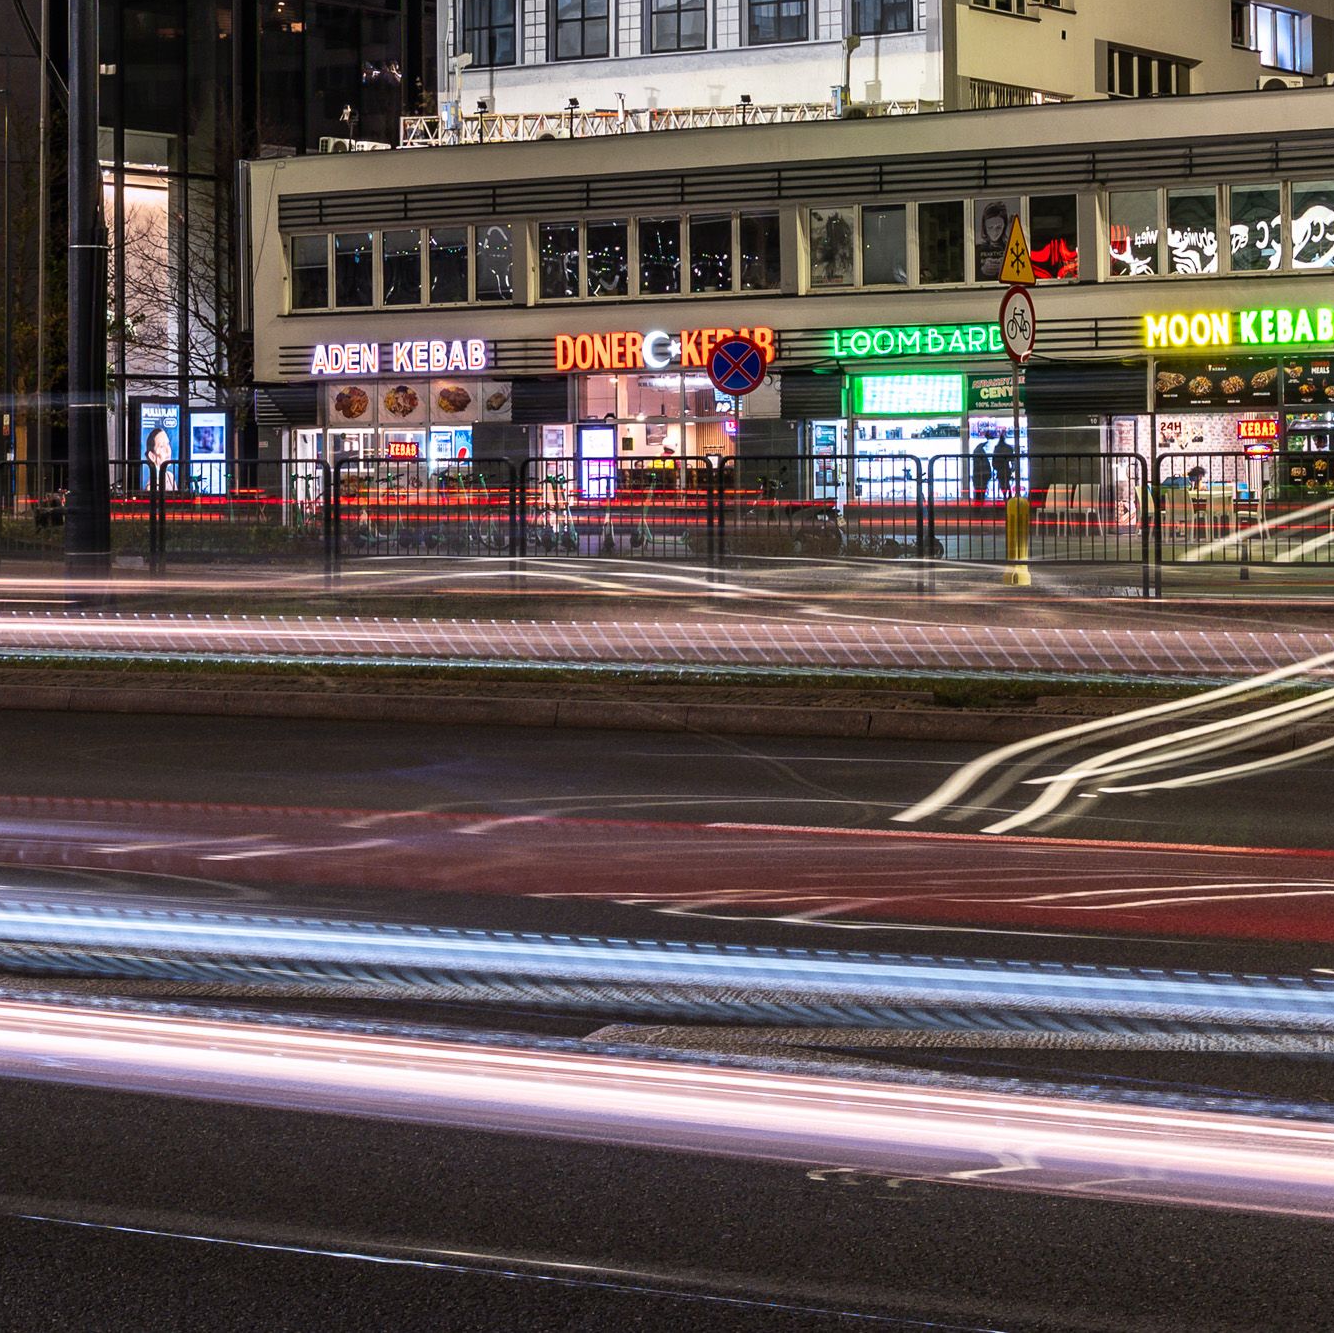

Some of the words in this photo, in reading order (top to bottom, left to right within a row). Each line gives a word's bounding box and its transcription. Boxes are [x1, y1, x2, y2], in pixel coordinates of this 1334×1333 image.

[1146, 312, 1232, 347] MOON
[1240, 308, 1334, 343] KEBAB
[556, 331, 644, 370] DONER
[680, 327, 776, 367] KEB
[833, 327, 1005, 356] LOOMBARD
[311, 344, 379, 374] ADEN
[392, 339, 485, 372] KEBAB
[1311, 366, 1330, 374] MEALS
[980, 386, 1014, 399] CENY
[1161, 421, 1182, 431] 24H
[1240, 421, 1276, 437] KEBAB
[389, 443, 417, 456] KEBAB
